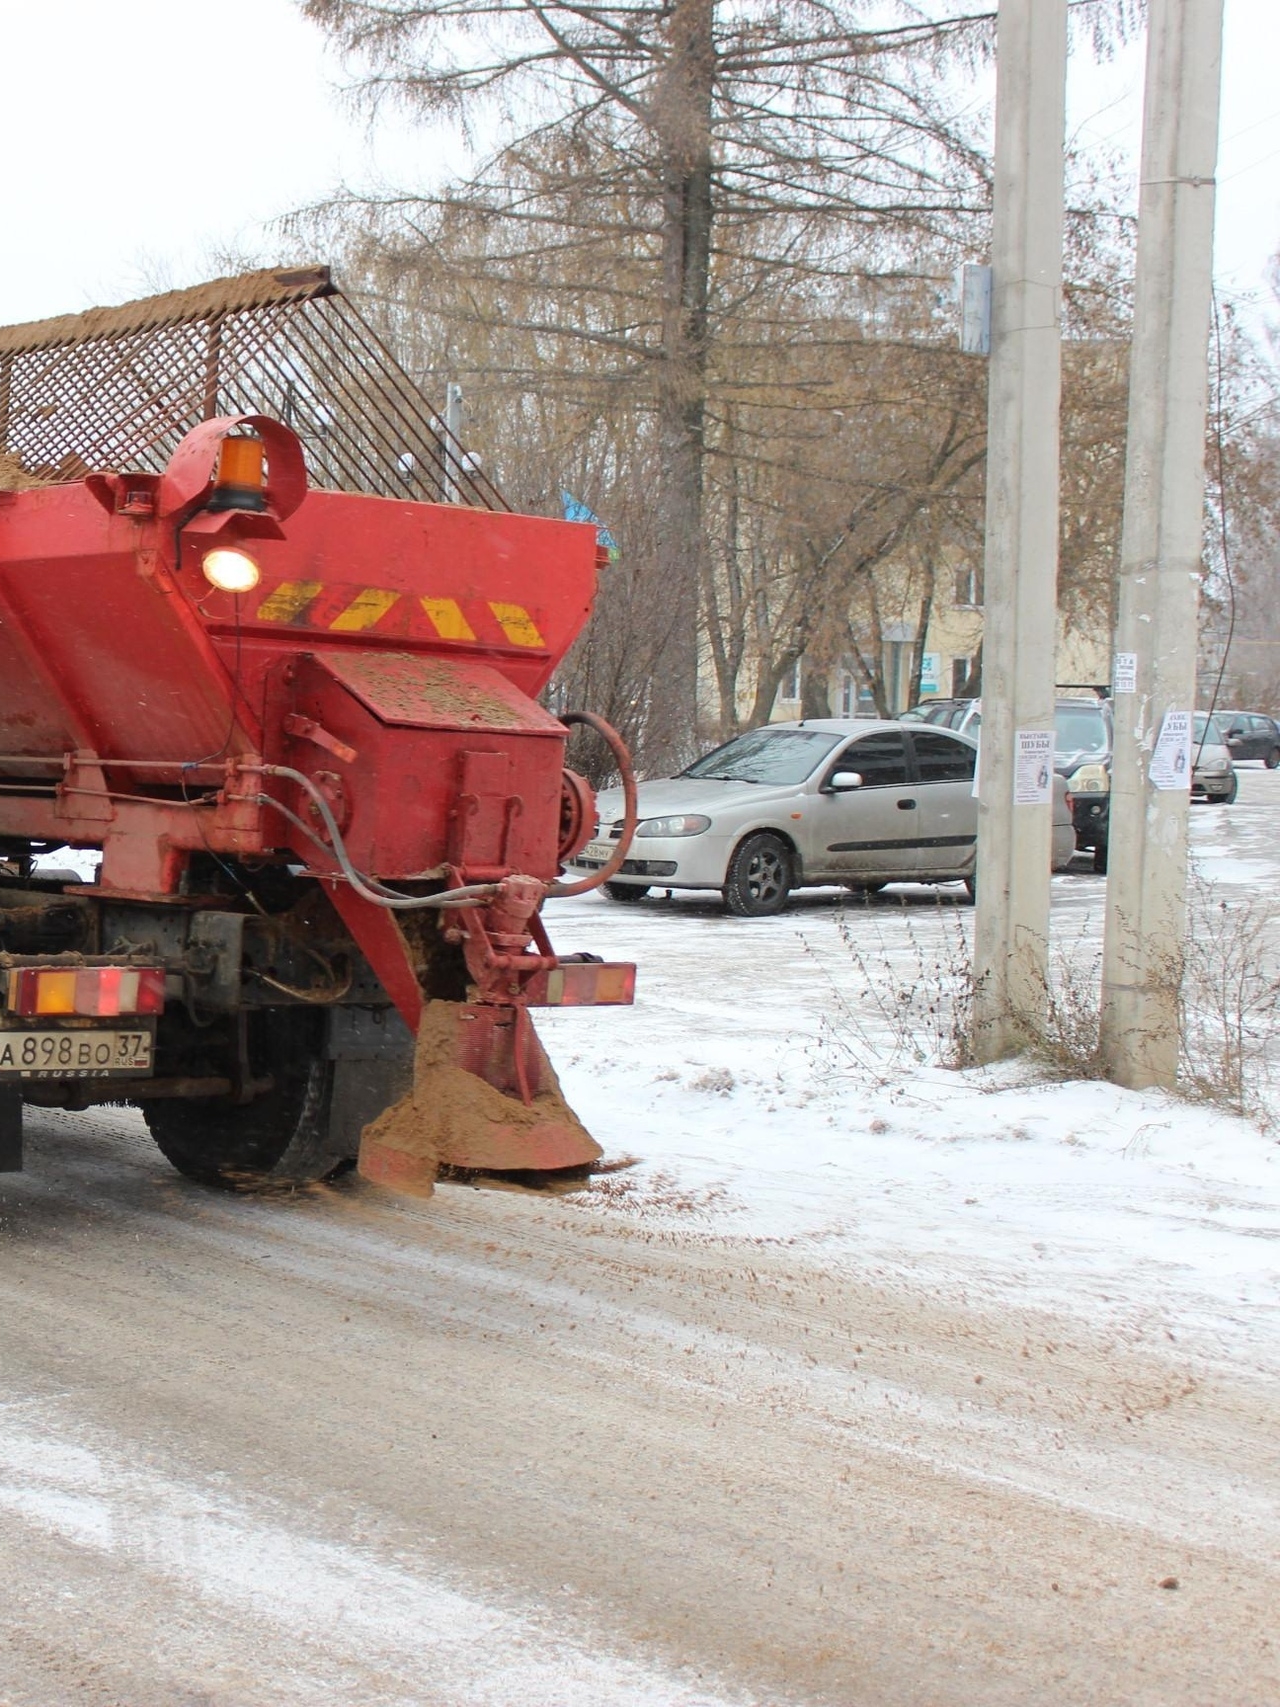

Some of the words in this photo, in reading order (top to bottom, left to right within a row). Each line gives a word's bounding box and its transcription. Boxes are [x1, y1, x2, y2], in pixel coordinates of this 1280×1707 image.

[1021, 740, 1050, 749] ШУБЫ
[118, 1035, 143, 1057] 37
[114, 1057, 134, 1066] RUS
[37, 1070, 110, 1078] RUSSIA
